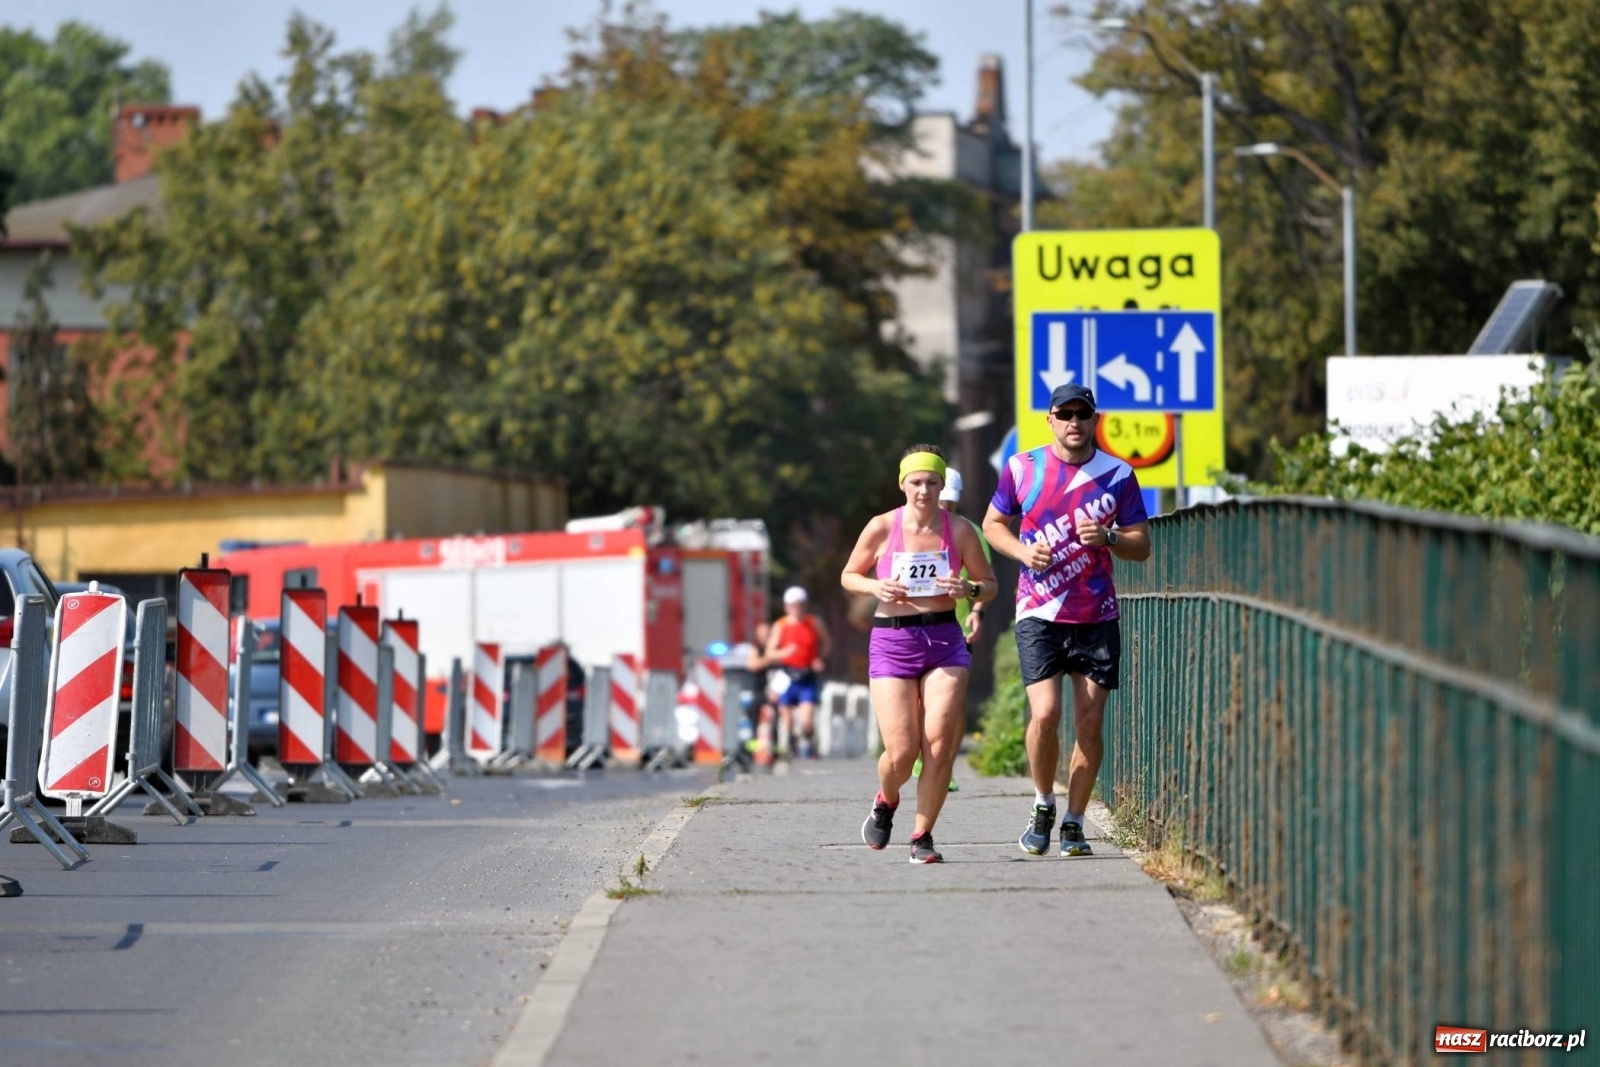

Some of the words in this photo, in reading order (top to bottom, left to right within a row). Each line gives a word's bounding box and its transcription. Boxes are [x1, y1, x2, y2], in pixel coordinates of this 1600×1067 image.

[1036, 244, 1195, 290] Uwaga
[909, 564, 937, 579] 272
[1034, 552, 1092, 597] 01.09.2019
